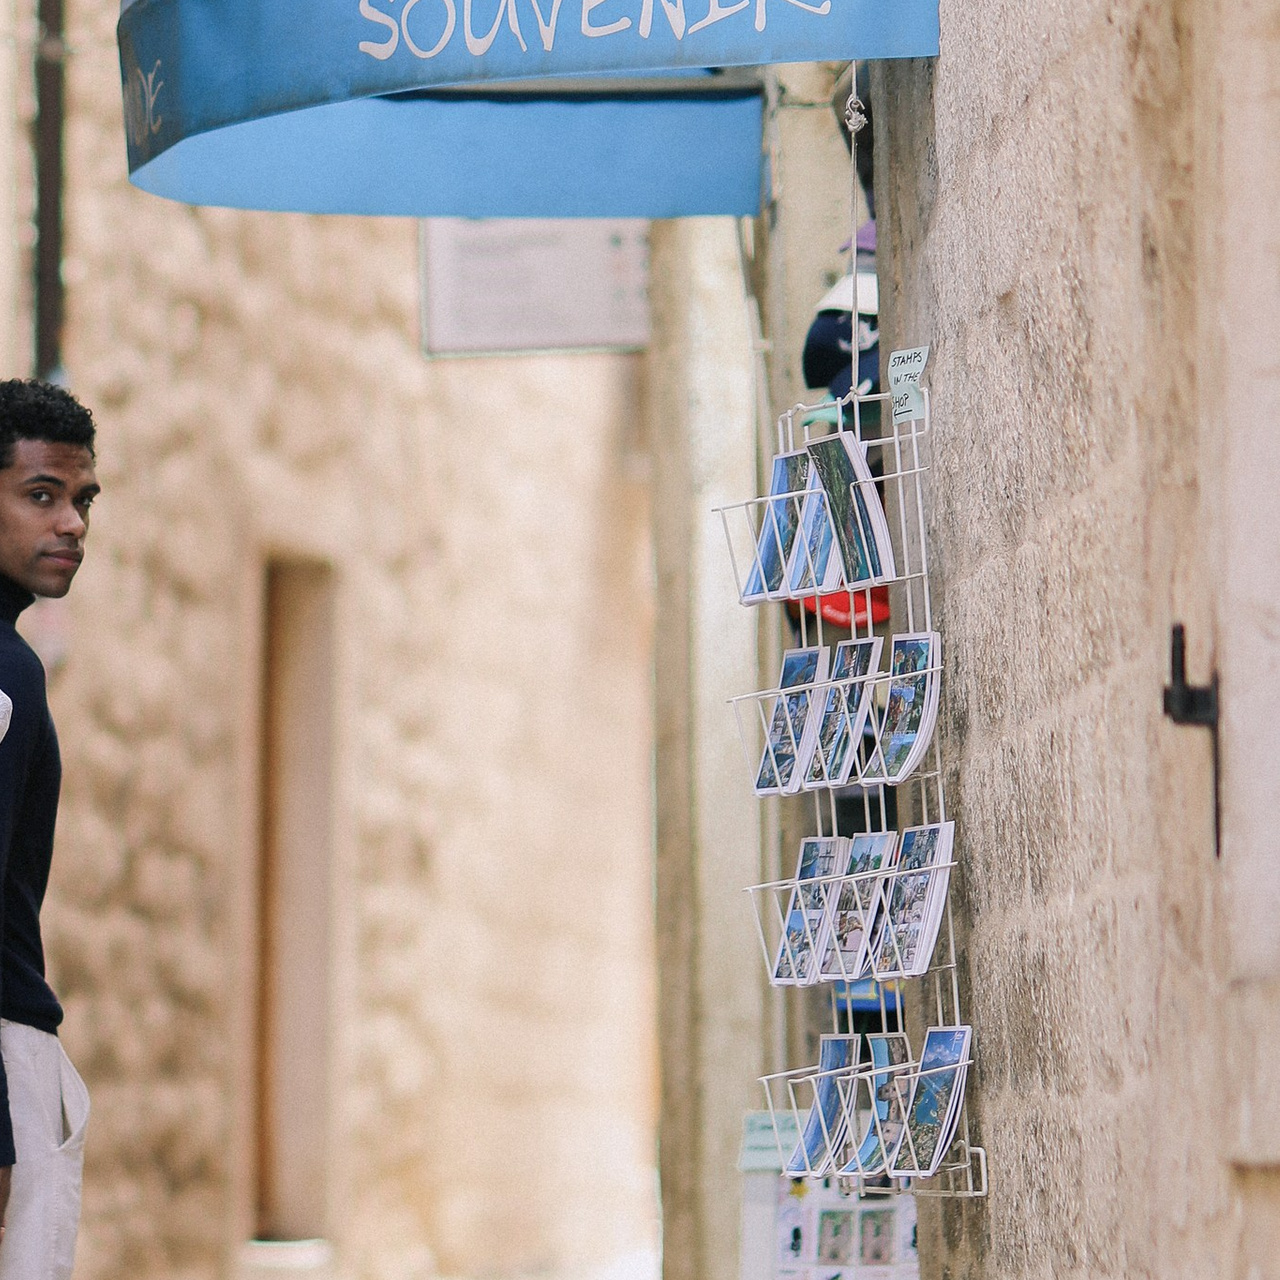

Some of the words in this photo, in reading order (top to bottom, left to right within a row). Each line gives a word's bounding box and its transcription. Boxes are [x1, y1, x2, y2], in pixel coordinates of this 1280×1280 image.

[891, 351, 923, 368] STAMPS
[893, 373, 903, 386] IN
[904, 371, 921, 383] THE
